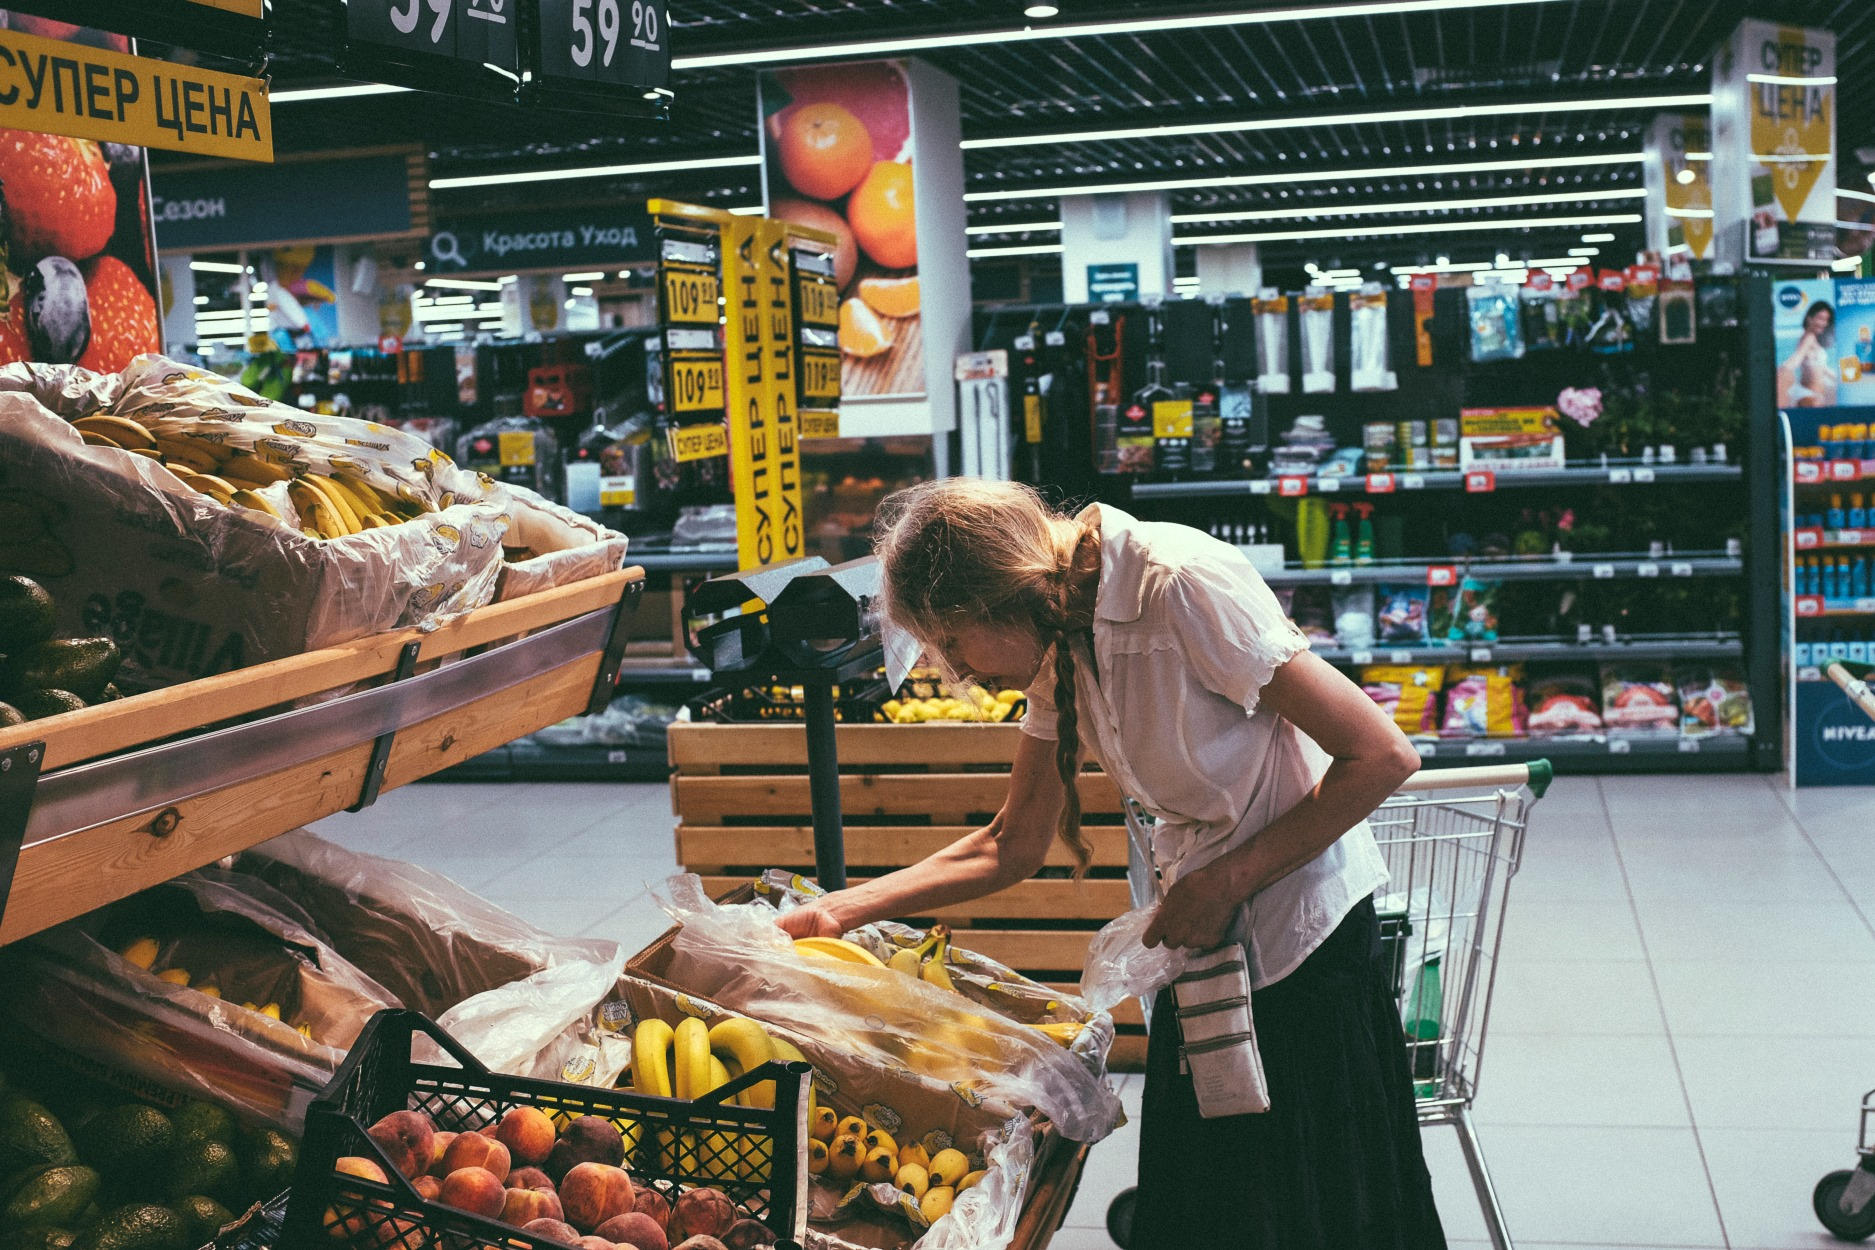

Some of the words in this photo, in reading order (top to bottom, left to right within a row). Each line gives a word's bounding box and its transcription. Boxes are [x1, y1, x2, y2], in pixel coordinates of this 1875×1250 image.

[571, 0, 619, 67] 59
[632, 0, 657, 42] 90
[0, 45, 139, 122] СУПЕР
[154, 75, 261, 141] ЦЕНА
[483, 231, 575, 256] Красота
[580, 225, 638, 247] Уход
[670, 279, 698, 315] 109
[739, 235, 763, 384] ЦЕНА
[767, 237, 790, 380] ЦЕНА
[677, 369, 705, 404] 109
[749, 397, 772, 565] СУПЕР
[777, 392, 799, 556] СУПЕР
